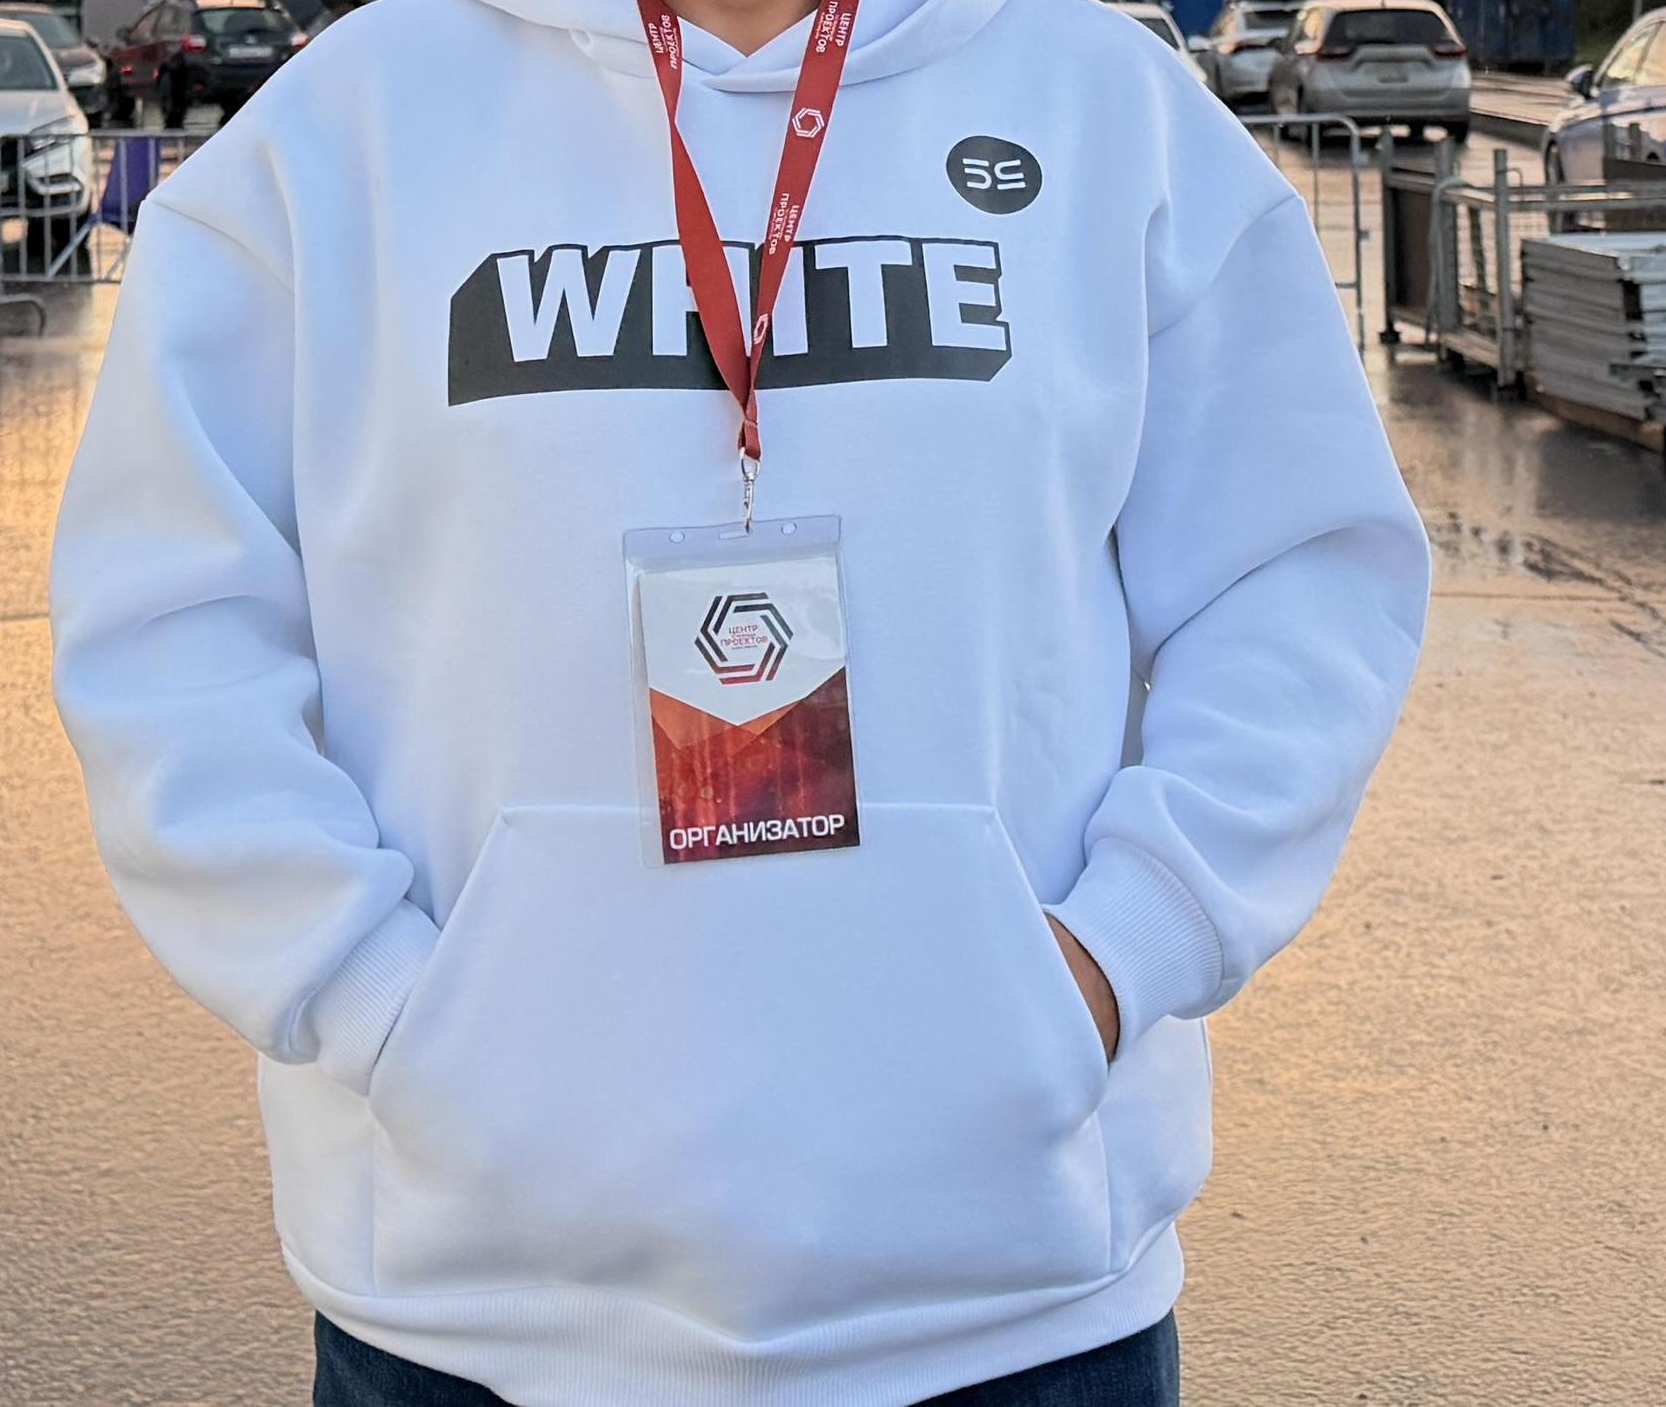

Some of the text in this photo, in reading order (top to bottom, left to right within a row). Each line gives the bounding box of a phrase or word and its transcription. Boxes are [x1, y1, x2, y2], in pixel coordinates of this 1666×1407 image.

[648, 22, 664, 54] ЦЕНТР
[661, 14, 678, 70] ПРОЕКТОВ
[815, 0, 839, 53] ПРОЕКТОВ
[834, 12, 852, 47] ЦЕНТР
[769, 193, 789, 255] ПРОЕКТОВ
[784, 204, 800, 242] ЦЕНТР
[493, 237, 1009, 364] WHITE
[720, 635, 768, 647] ПРОЕКТОВ
[728, 625, 758, 635] ЦЕНТР
[669, 814, 846, 851] ОРГАНИЗАТОР
